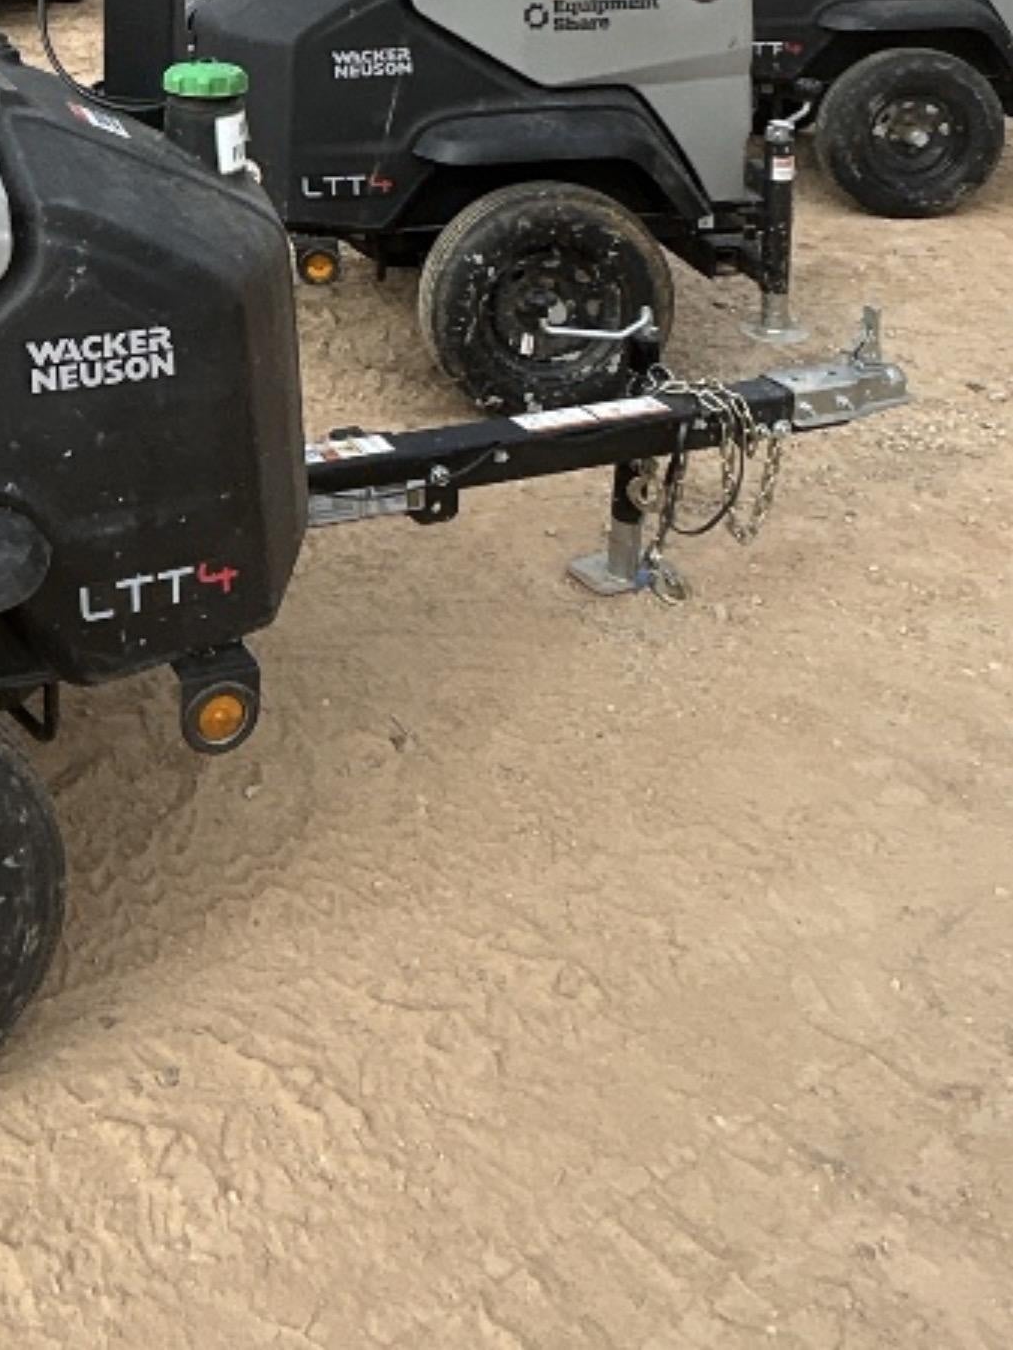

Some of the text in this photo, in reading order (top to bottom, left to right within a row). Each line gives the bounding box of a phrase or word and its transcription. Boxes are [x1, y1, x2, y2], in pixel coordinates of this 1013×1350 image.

[553, 16, 610, 32] Share
[331, 47, 412, 65] WACKER
[333, 61, 414, 80] NEUSON
[300, 174, 394, 199] LTT4
[26, 326, 174, 367] WACKER
[30, 350, 177, 394] NEUSON
[79, 562, 238, 622] LTT4
